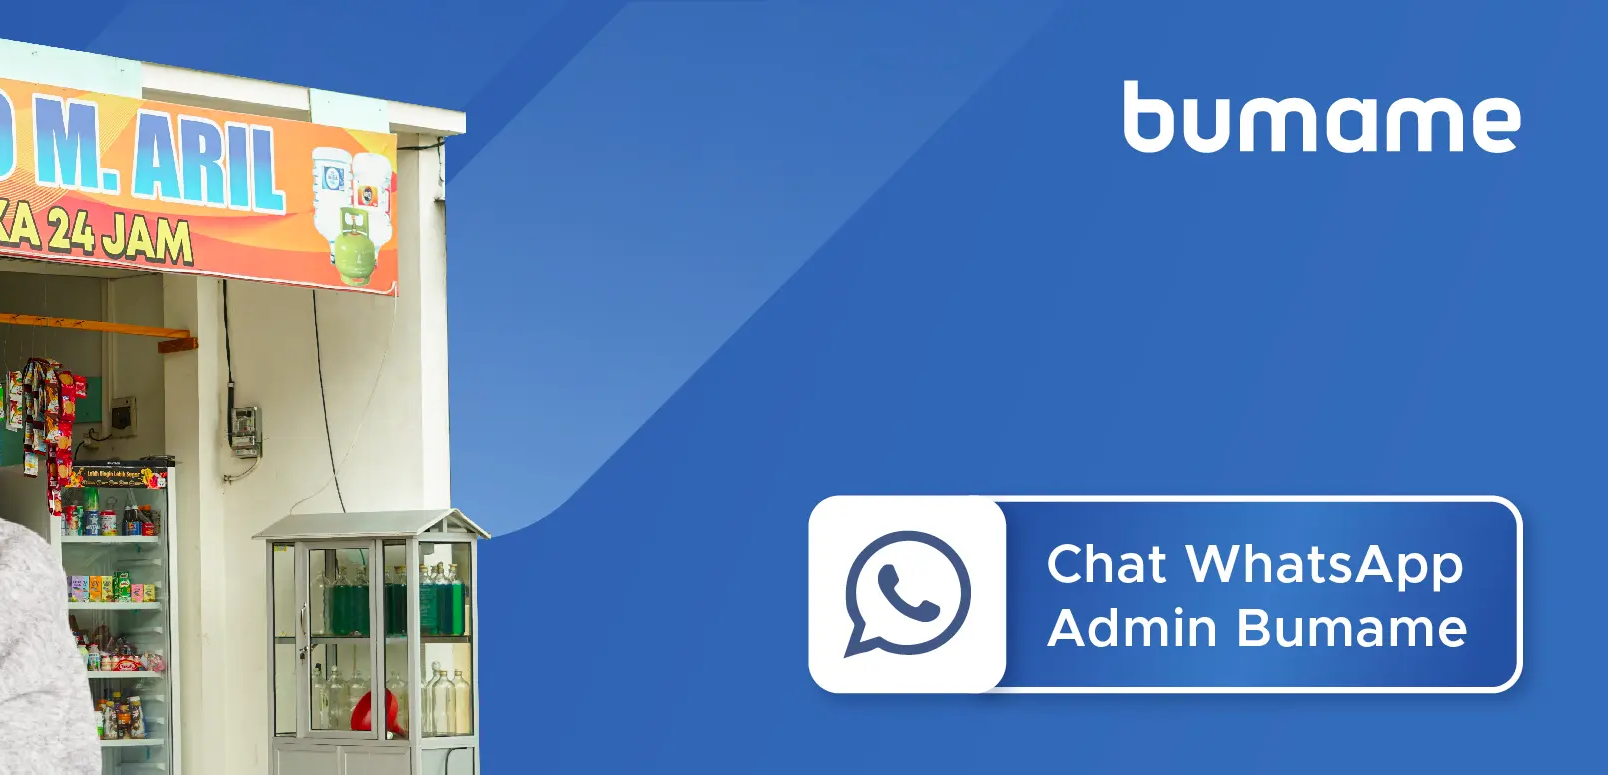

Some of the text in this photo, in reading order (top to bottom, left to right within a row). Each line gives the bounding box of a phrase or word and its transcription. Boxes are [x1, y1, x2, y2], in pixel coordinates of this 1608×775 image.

[32, 93, 121, 196] M.
[131, 108, 286, 215] ARIL
[47, 206, 95, 255] 24
[101, 212, 194, 266] JAM
